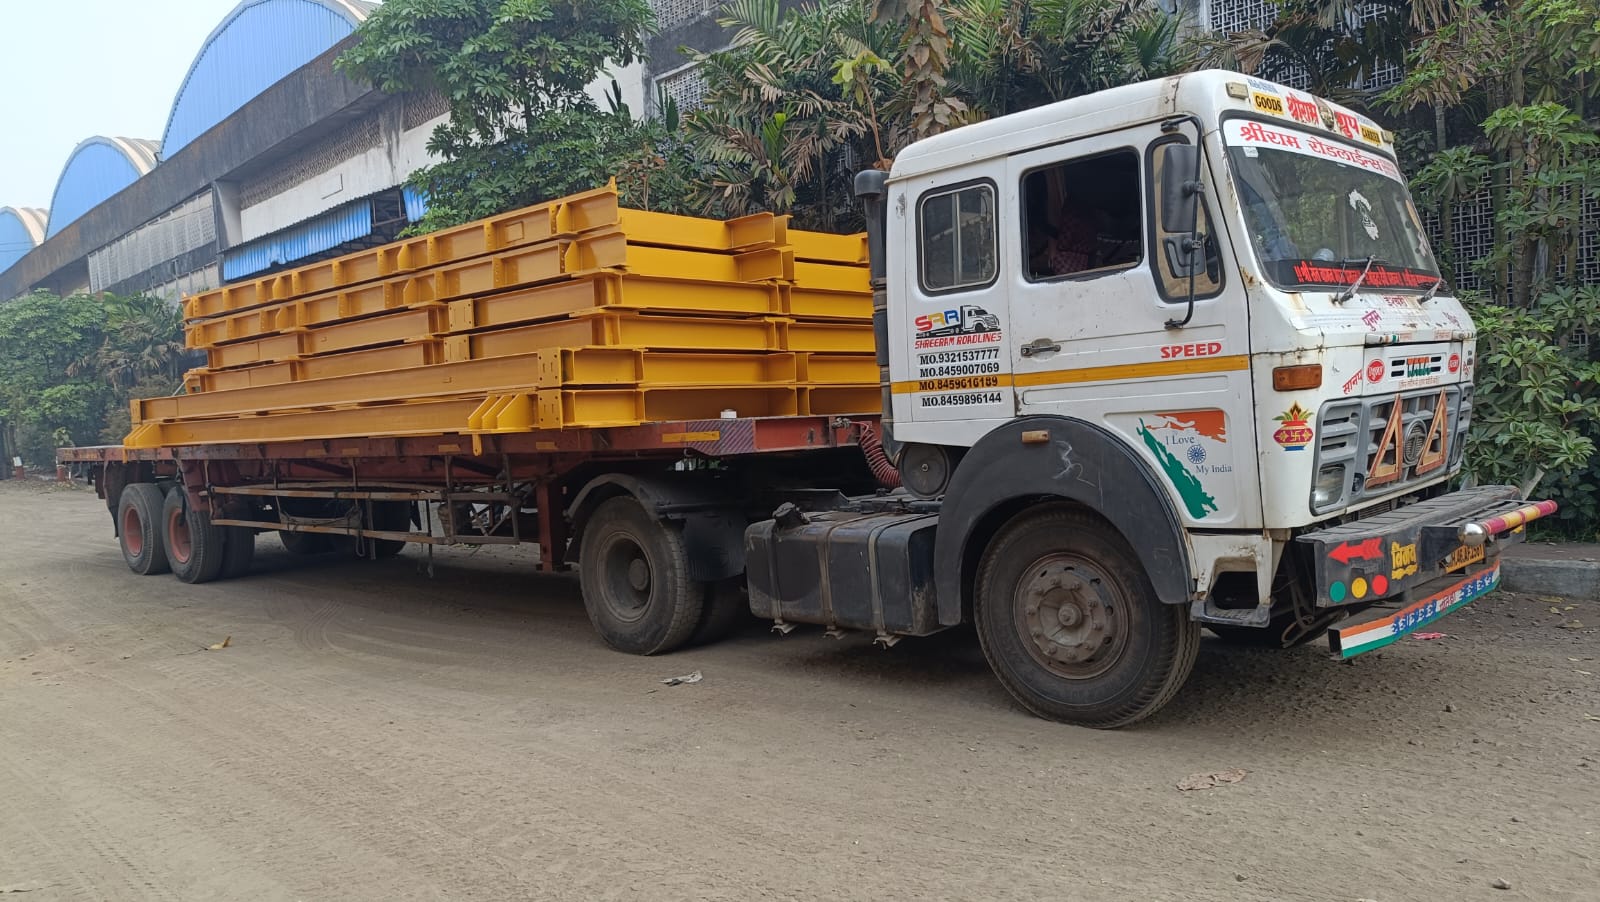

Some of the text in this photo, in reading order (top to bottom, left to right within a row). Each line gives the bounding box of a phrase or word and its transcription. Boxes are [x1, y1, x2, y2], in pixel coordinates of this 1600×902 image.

[1255, 95, 1283, 112] GOODS
[1240, 122, 1301, 149] श्रीराम
[915, 332, 1002, 349] SHREERAM ROADLINES
[920, 348, 999, 365] MO.9321537777
[1160, 342, 1222, 359] SPEED
[920, 362, 1000, 378] MO.8459007069
[922, 392, 1002, 407] MO.8459896144
[1172, 434, 1195, 445] Love
[1196, 464, 1232, 475] My India
